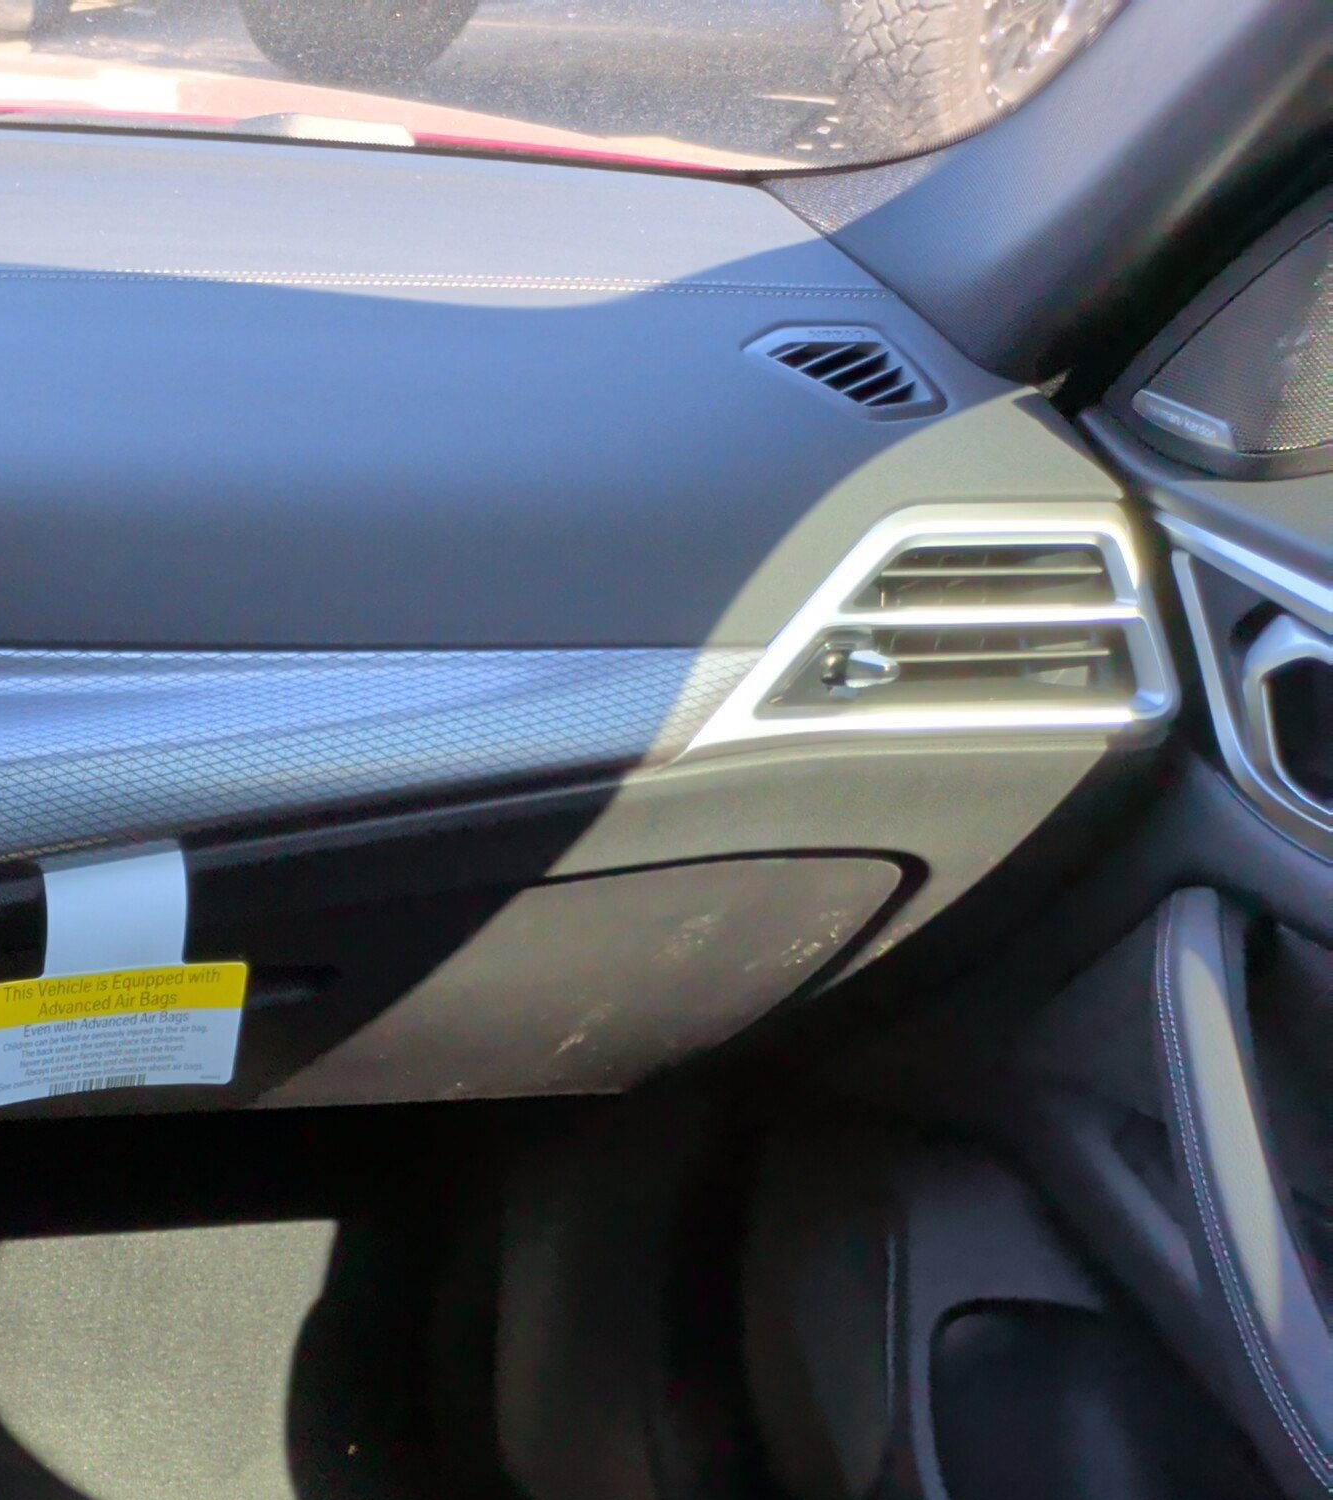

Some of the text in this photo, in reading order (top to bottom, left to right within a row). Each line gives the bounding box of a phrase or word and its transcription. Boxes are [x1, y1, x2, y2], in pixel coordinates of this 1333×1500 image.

[4, 967, 221, 1002] This Vehicle is Equipped with
[38, 991, 178, 1018] Advanced Air Bags
[23, 1010, 190, 1038] Even with Advanced Air Bags
